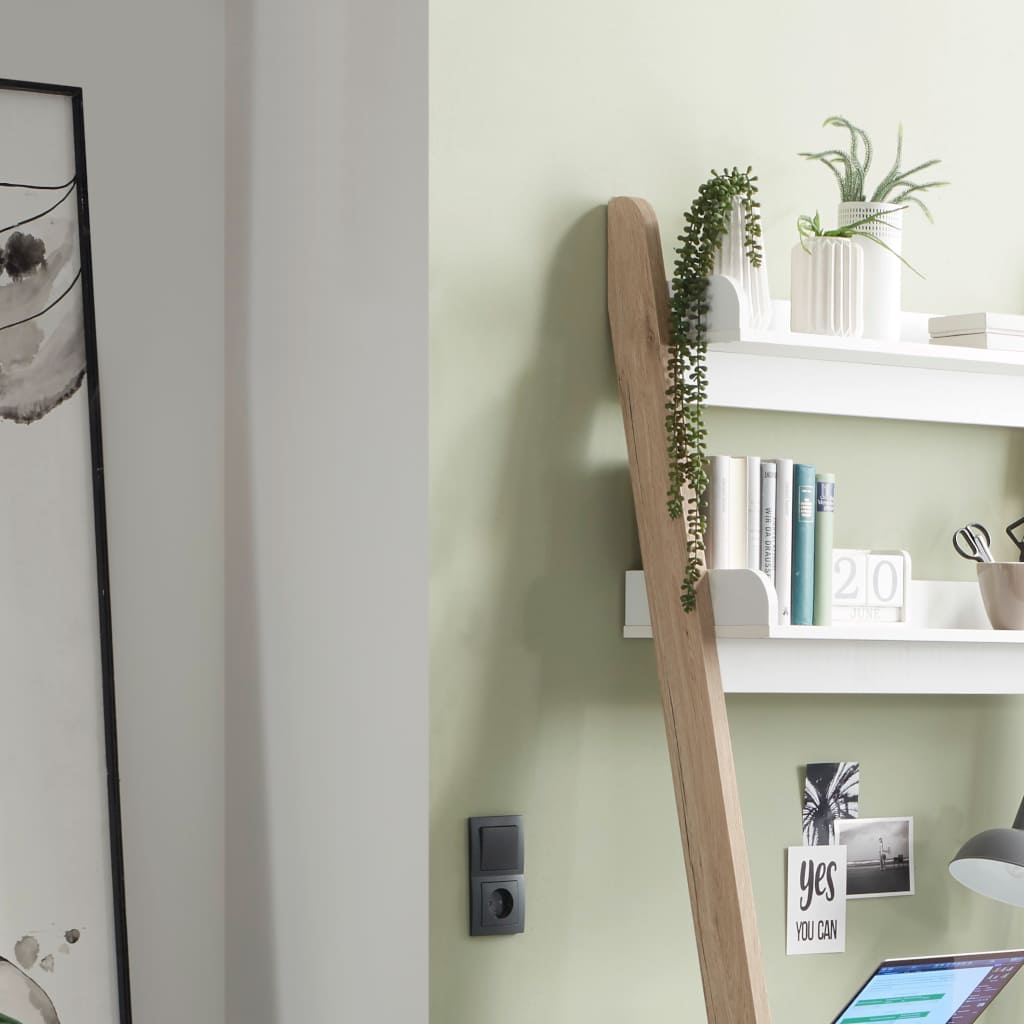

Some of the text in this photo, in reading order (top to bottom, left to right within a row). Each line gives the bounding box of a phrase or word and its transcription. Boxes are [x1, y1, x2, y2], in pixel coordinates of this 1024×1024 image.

[834, 557, 898, 602] 20
[849, 606, 881, 620] JUNE
[799, 858, 838, 912] yes
[795, 919, 838, 942] YOU CAN
